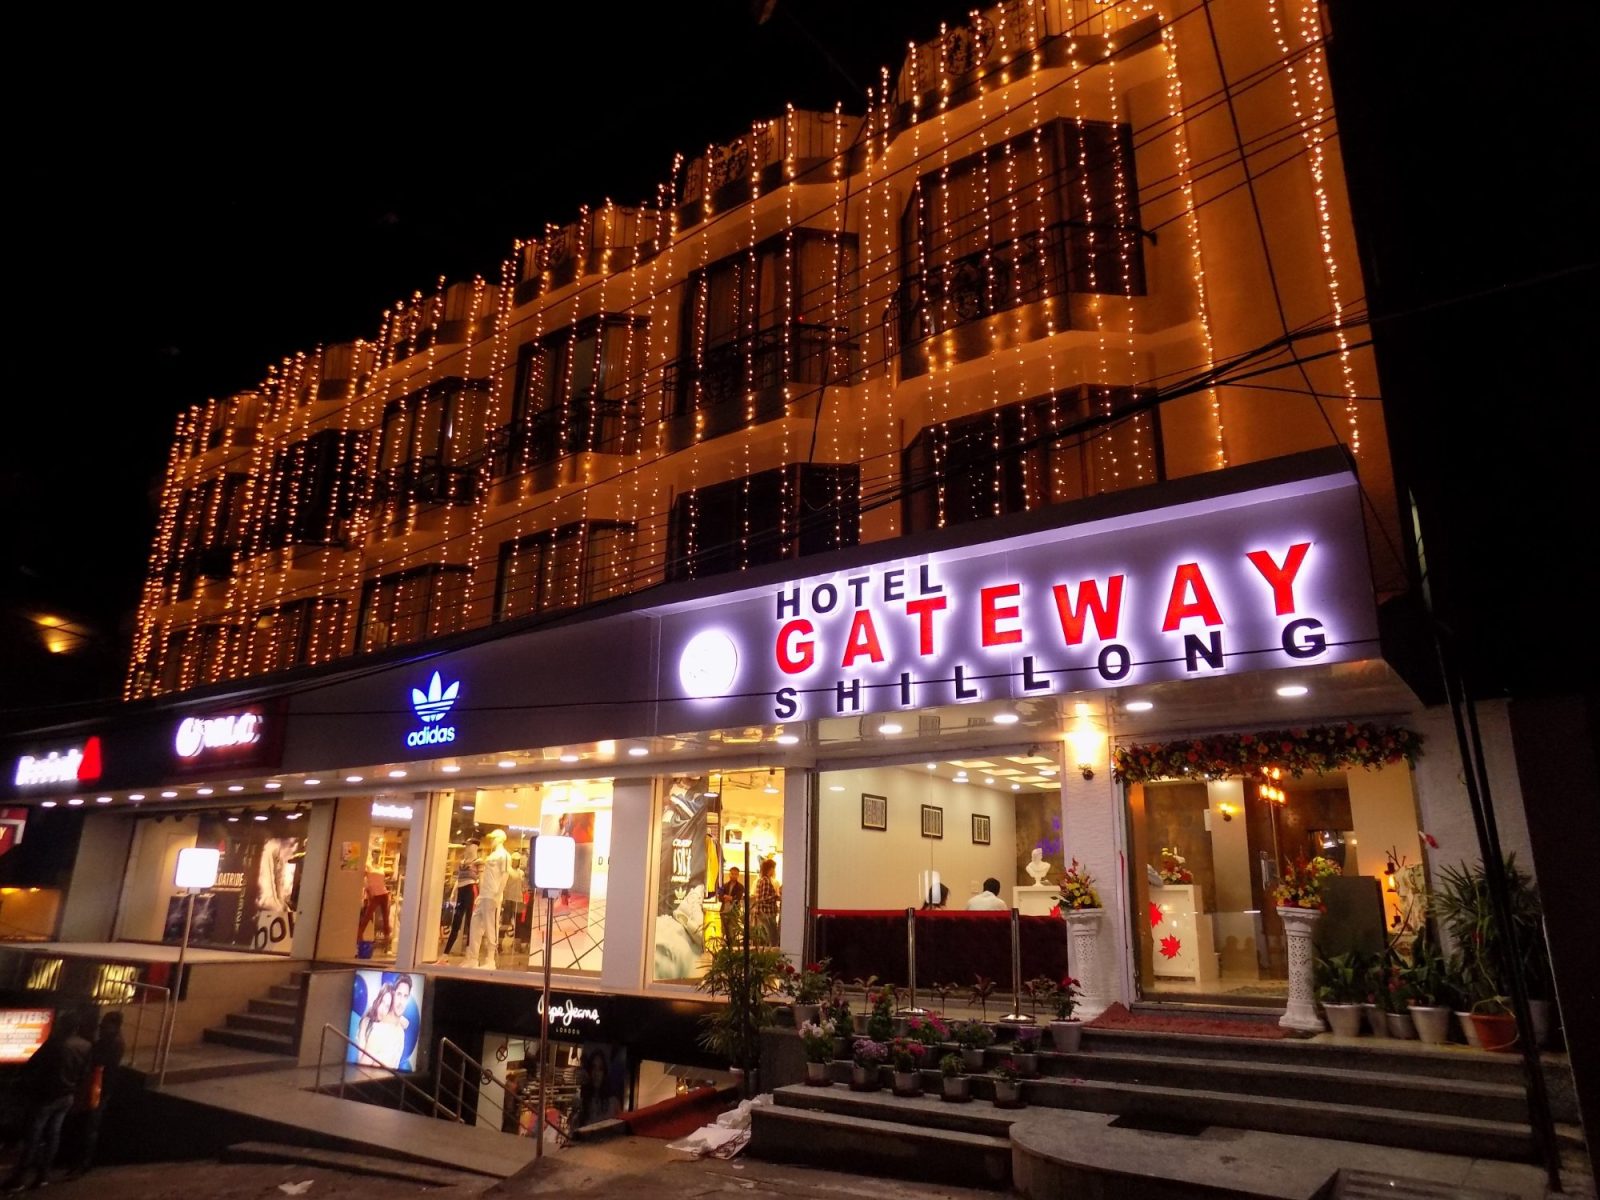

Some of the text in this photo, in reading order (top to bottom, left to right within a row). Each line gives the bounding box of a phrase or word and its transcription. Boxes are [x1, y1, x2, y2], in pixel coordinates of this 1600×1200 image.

[775, 543, 1312, 674] GATEWAY
[776, 565, 943, 620] HOTEL
[774, 617, 1327, 719] SHILLONG
[407, 725, 455, 747] adidas
[215, 872, 245, 886] OATRIDE
[537, 994, 565, 1024] Ppe
